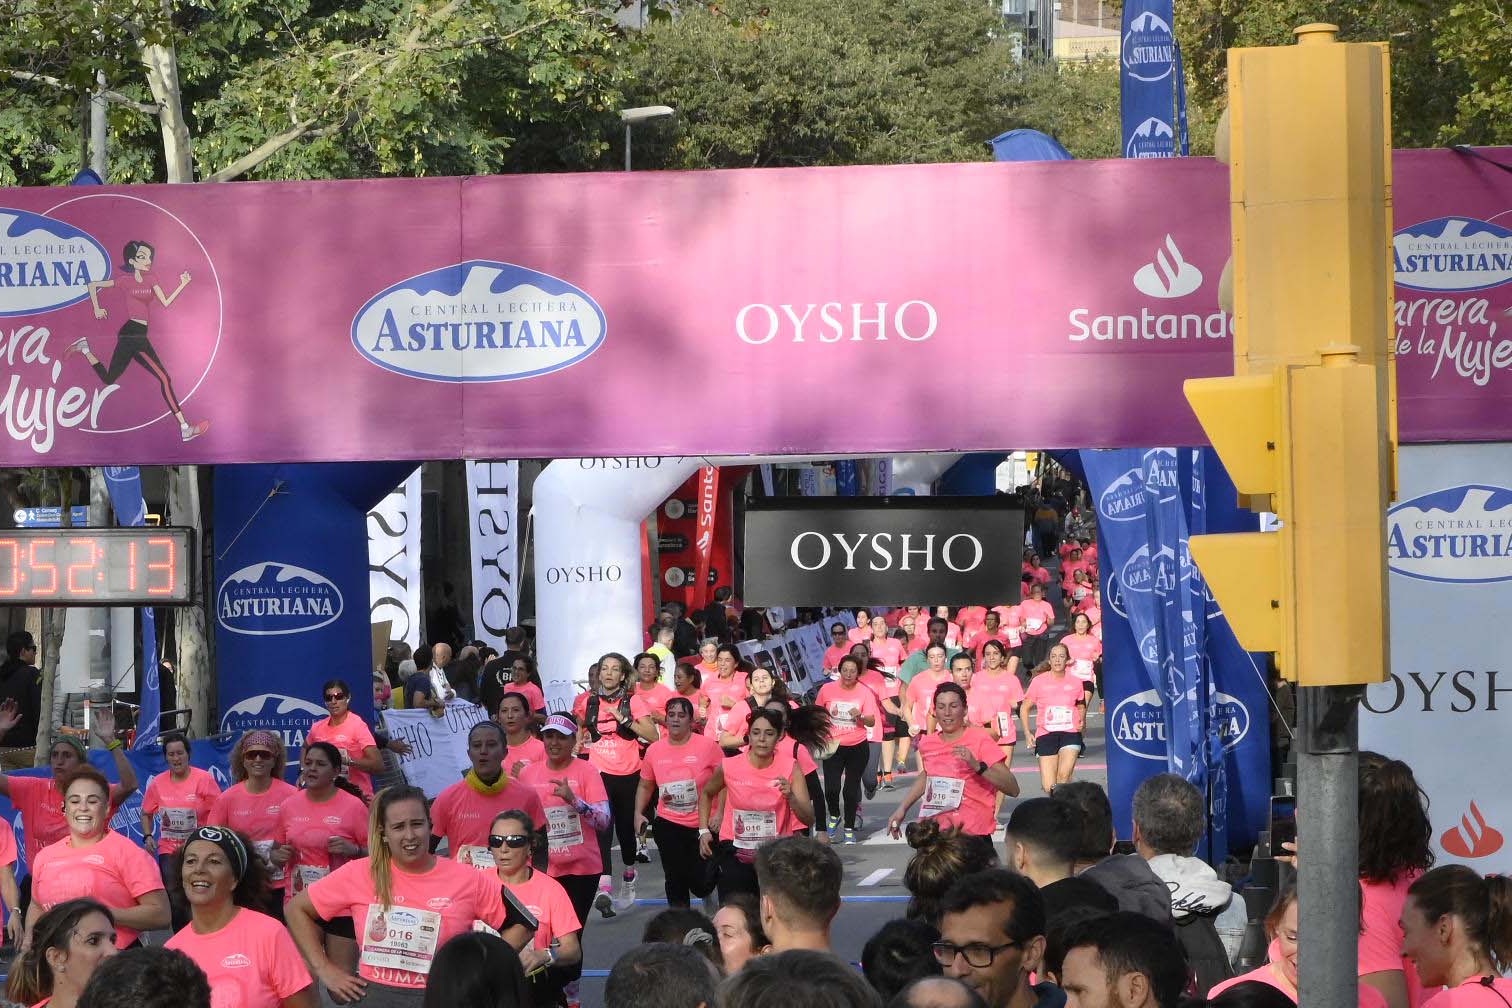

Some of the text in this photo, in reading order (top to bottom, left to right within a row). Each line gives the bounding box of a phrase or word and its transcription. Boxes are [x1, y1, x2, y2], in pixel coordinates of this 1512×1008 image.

[14, 244, 86, 255] LECHERA
[1408, 240, 1512, 250] CENTRAL LECHER
[410, 300, 578, 317] CENTRAL LECHERA
[1394, 298, 1489, 327] arrera
[372, 308, 586, 352] ASTURIANA
[735, 300, 938, 345] OYSHO
[1068, 307, 1235, 342] Santand
[1417, 328, 1435, 354] la
[1431, 321, 1512, 386] Muje
[1415, 519, 1483, 529] CENTRAL
[790, 531, 983, 572] OYSHO
[547, 565, 622, 585] OYSHO
[233, 586, 330, 595] CENTRAL LECHERA
[221, 594, 334, 618] ASTURIANA
[235, 719, 277, 727] CENTRAL
[552, 821, 566, 830] 016
[389, 929, 413, 941] 016
[372, 967, 426, 985] SUMA
